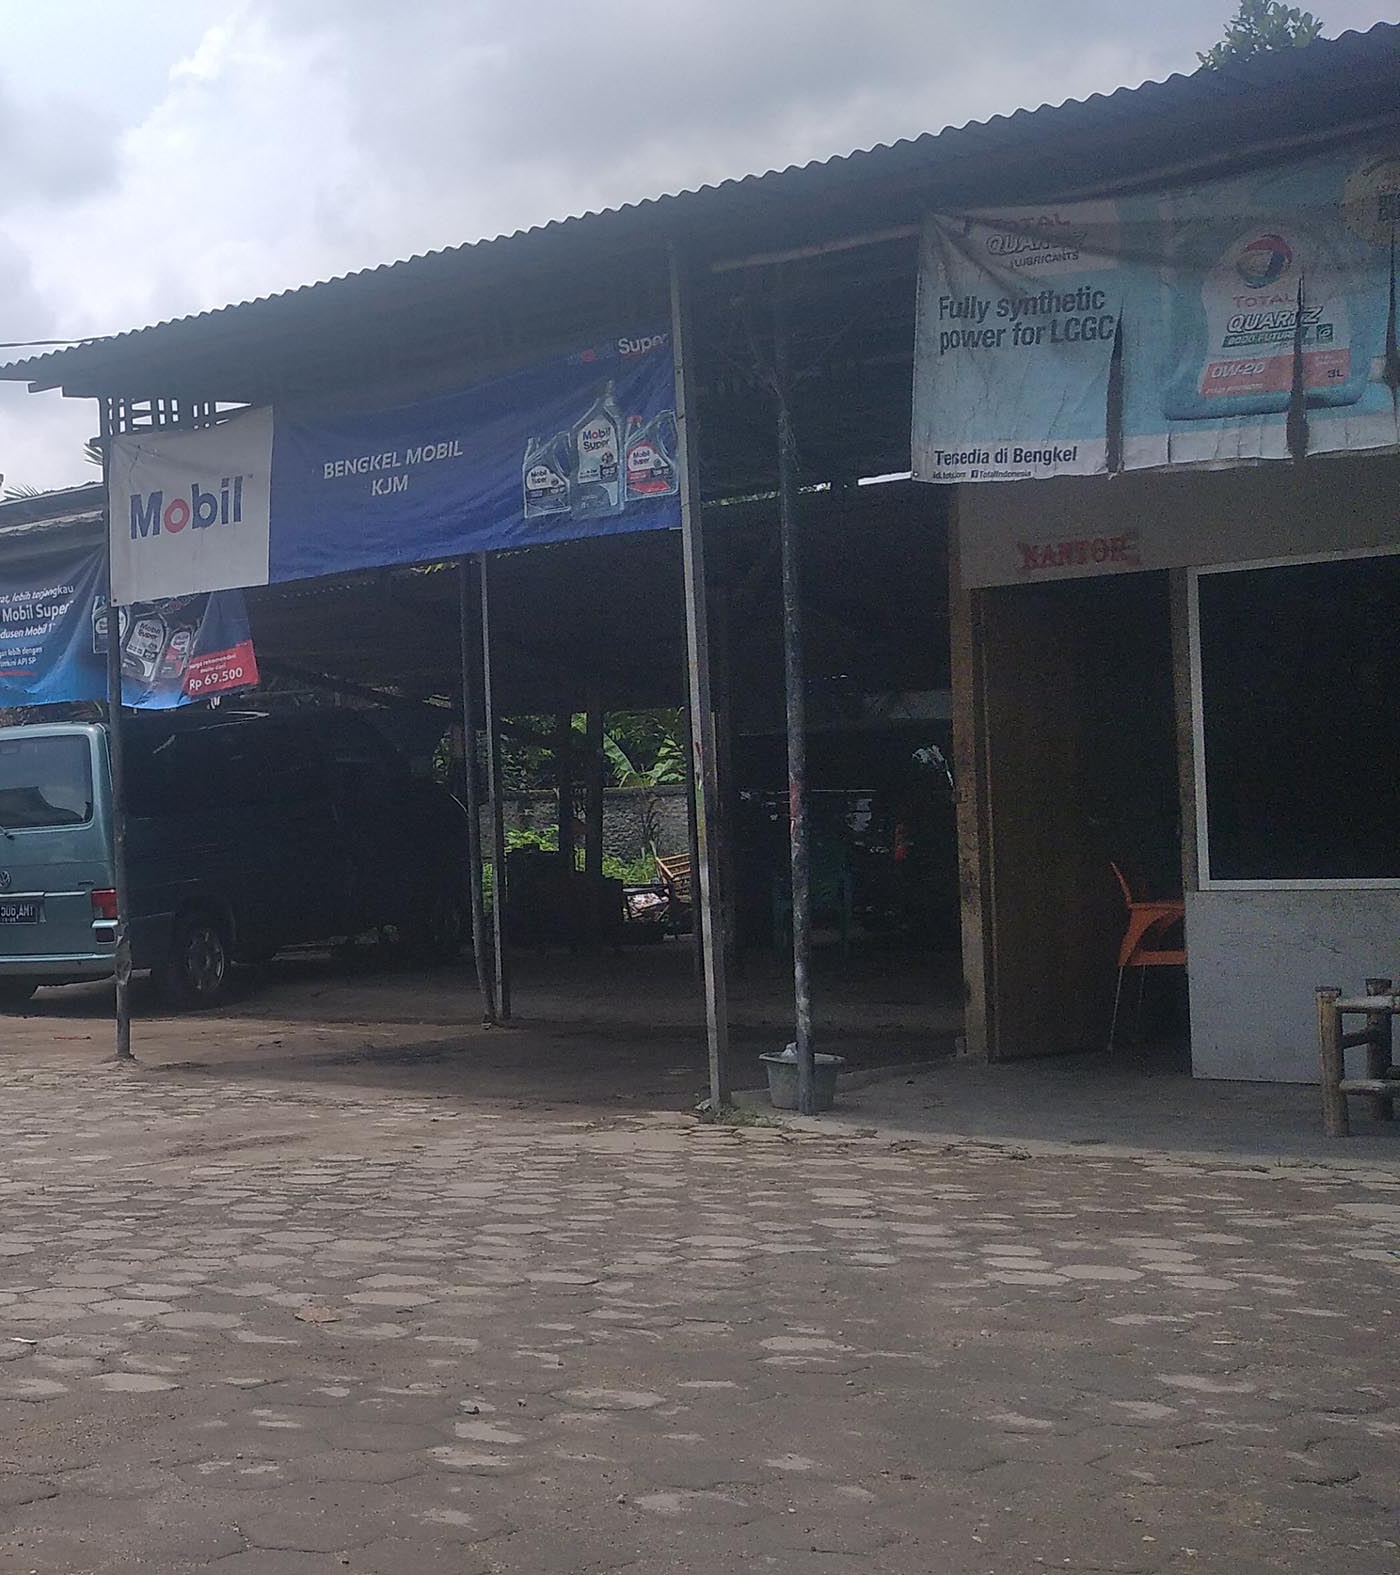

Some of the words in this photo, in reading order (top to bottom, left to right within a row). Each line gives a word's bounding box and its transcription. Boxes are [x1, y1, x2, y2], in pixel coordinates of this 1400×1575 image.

[939, 296, 989, 324] Fully
[996, 286, 1106, 322] synthetic
[940, 327, 1006, 356] power
[1013, 321, 1046, 346] for
[1051, 315, 1114, 344] LCGC
[1328, 367, 1344, 378] 3L
[582, 426, 610, 441] Mobil
[583, 439, 610, 450] Super
[324, 451, 402, 479] BENGKEL
[406, 439, 463, 465] MOBIL
[995, 447, 1008, 464] di
[1013, 446, 1077, 466] Bengkel
[371, 474, 409, 496] KJM
[130, 475, 244, 540] Mobil
[11, 592, 31, 603] lebih
[2, 604, 33, 622] Mobil
[35, 602, 70, 621] Super
[24, 623, 47, 636] Mobil
[189, 679, 202, 691] Rp
[204, 667, 243, 686] 69.500
